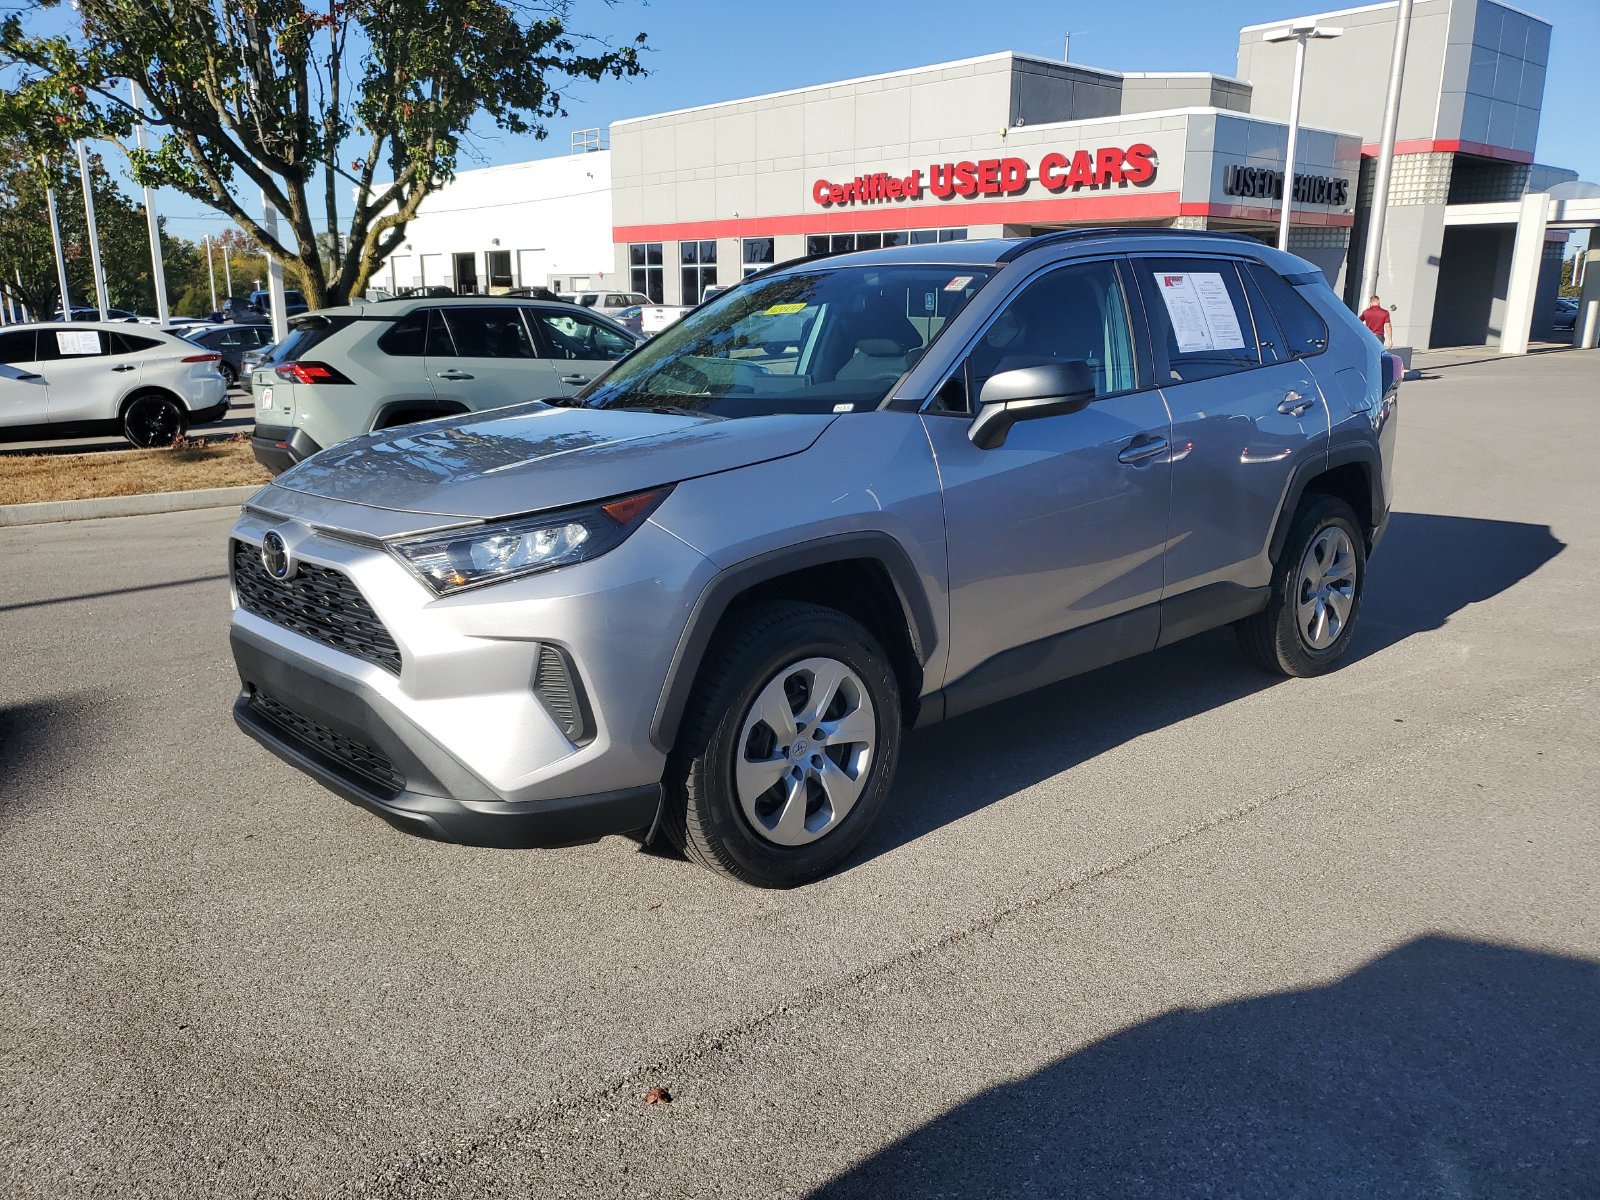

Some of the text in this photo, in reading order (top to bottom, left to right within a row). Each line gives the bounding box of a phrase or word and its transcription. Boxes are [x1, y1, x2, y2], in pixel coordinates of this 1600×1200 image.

[812, 143, 1155, 206] Certified USED CARS
[1224, 165, 1349, 206] USED EHICLES
